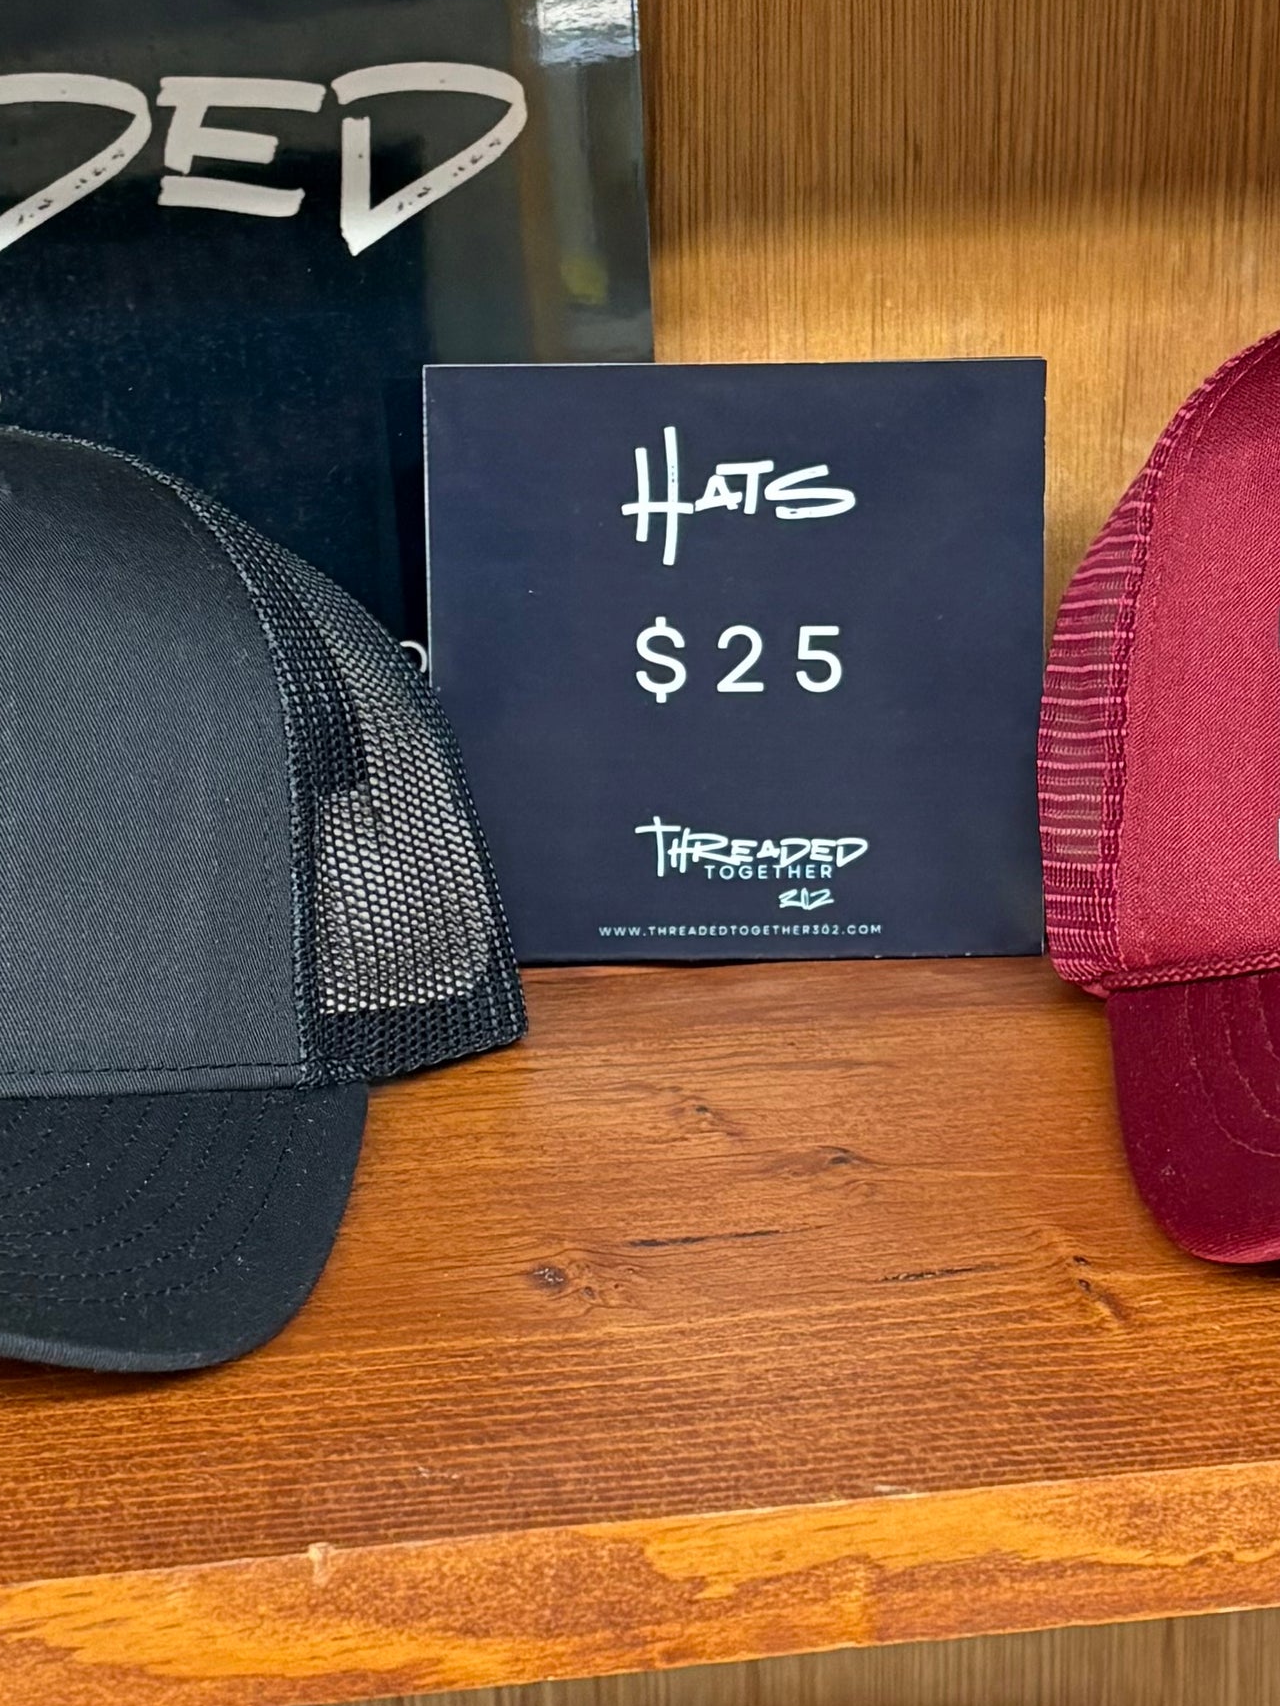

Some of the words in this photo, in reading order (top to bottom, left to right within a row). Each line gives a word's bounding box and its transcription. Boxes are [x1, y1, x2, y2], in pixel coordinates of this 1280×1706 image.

[634, 615, 843, 704] $25
[634, 815, 869, 878] THREADED
[704, 864, 833, 880] TOGETHER
[598, 923, 883, 937] WWW.THREADEDTOGETHER302.COM
